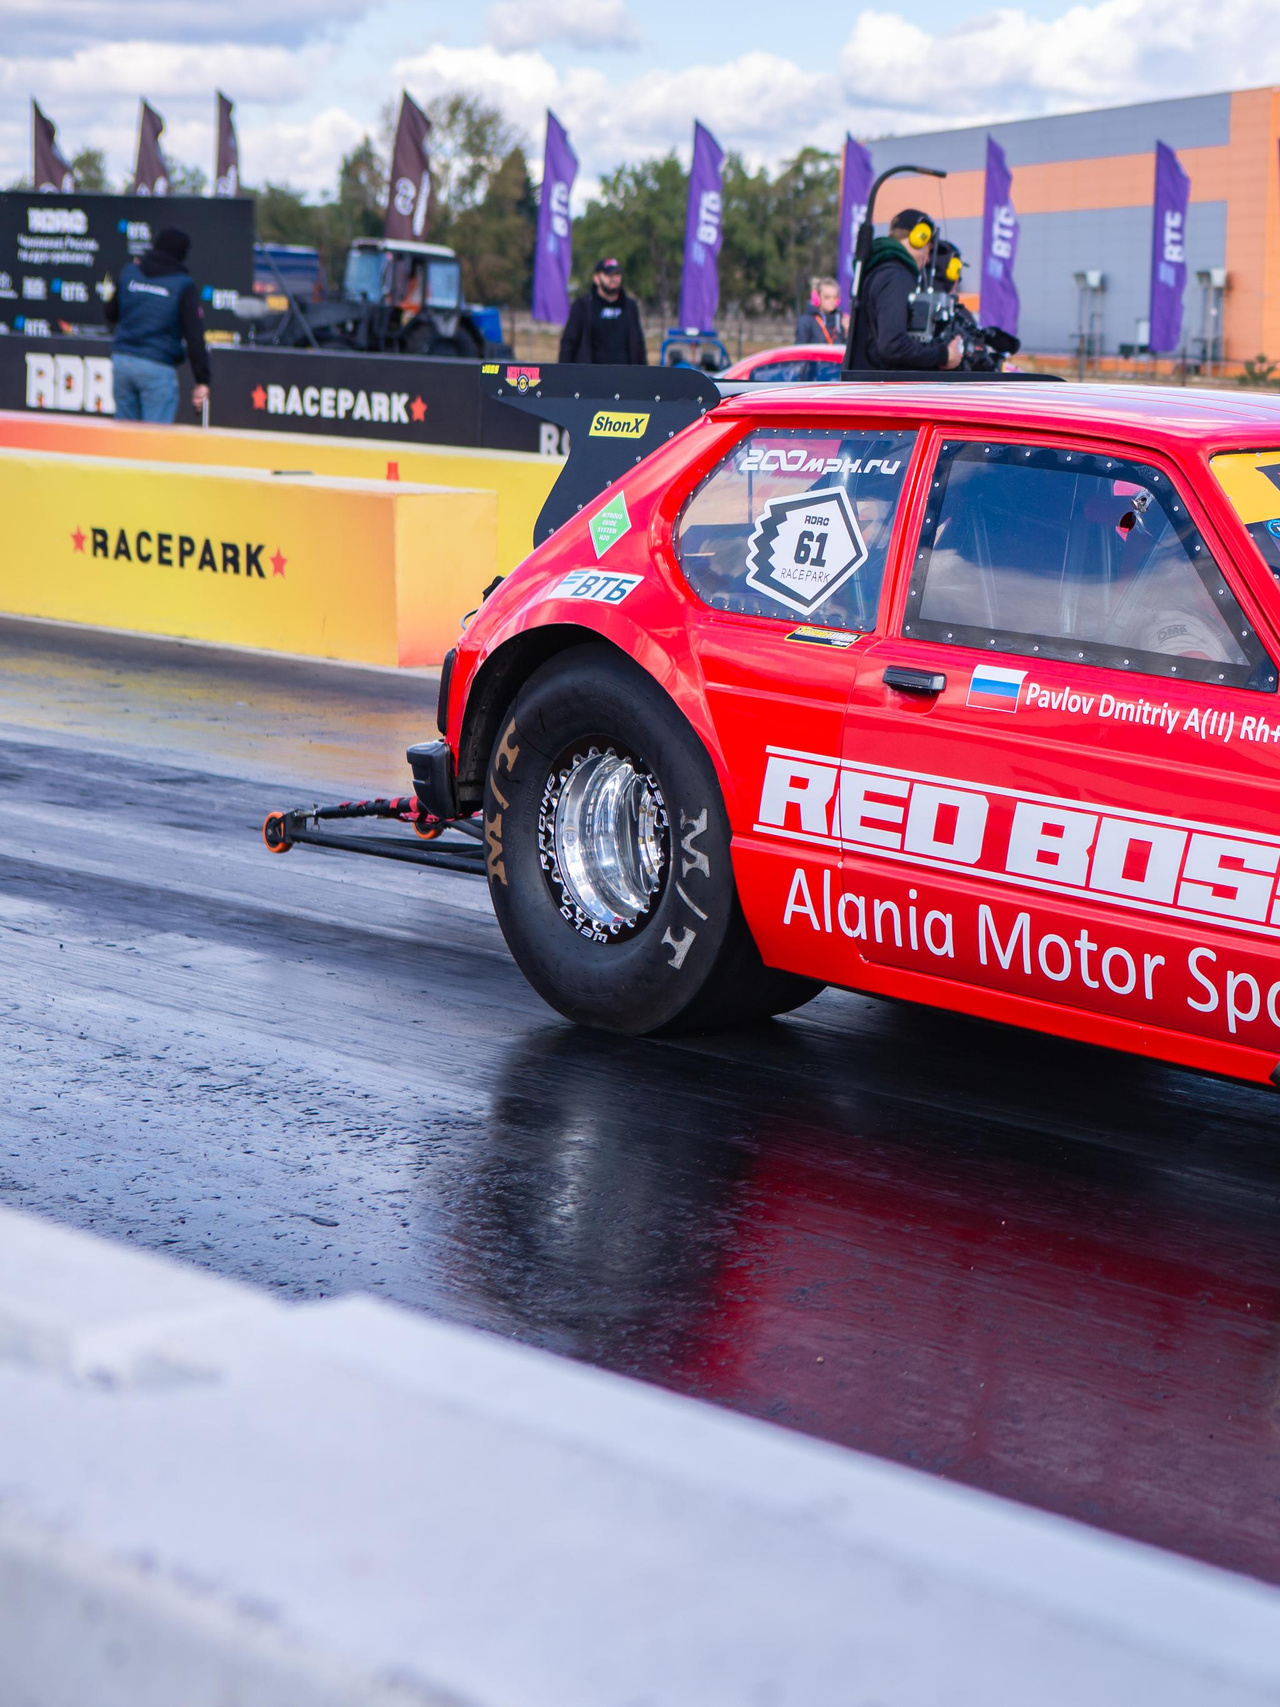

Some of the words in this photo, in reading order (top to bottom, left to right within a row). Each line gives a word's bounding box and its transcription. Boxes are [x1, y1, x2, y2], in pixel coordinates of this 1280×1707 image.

[26, 353, 116, 415] RDR
[266, 384, 410, 424] RACEPARK
[593, 416, 645, 434] ShonX
[597, 526, 617, 534] SYSTEM
[601, 512, 623, 520] NITROUS
[804, 515, 830, 527] RDRC
[91, 527, 266, 579] RACEPARK
[793, 530, 829, 568] 61
[570, 575, 637, 601] ВТБ
[780, 567, 831, 584] RACEPARK
[1024, 682, 1093, 714] Pavlov
[1098, 693, 1184, 734] Dmitriy
[646, 774, 669, 828] USA
[758, 756, 990, 865] RED
[538, 773, 556, 870] RACING
[559, 905, 608, 944] WELD
[783, 867, 955, 958] Alania
[977, 903, 1166, 1001] Motor
